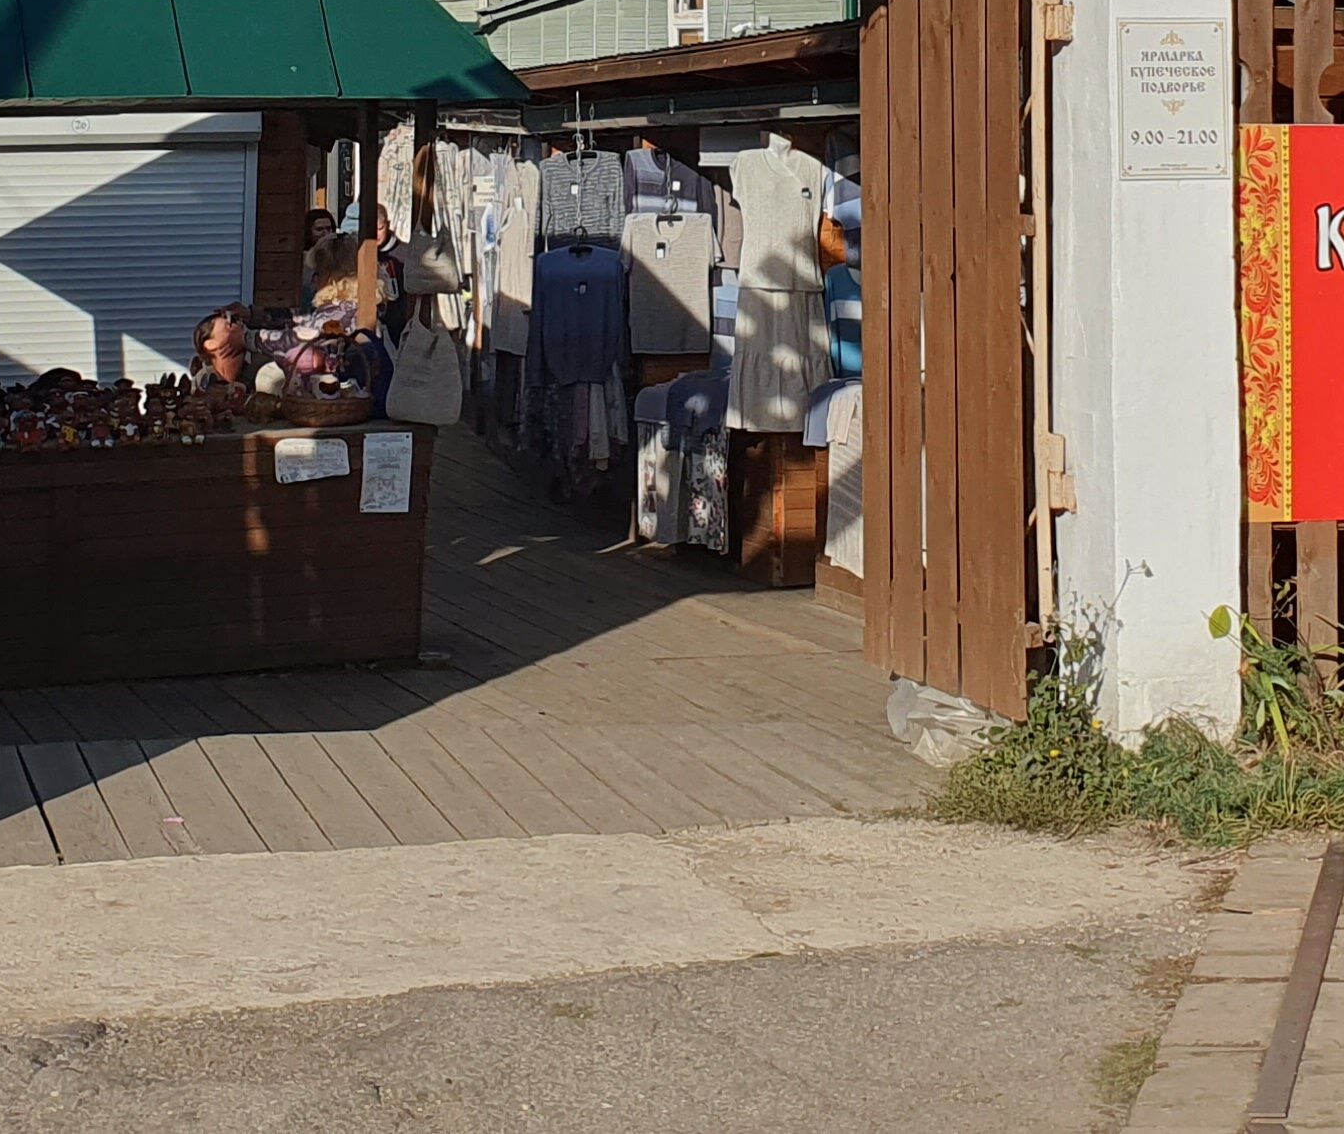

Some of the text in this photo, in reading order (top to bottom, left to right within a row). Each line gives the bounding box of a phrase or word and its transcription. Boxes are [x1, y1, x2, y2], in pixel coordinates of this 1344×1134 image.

[1141, 50, 1204, 62] ЯРМАРКА
[1130, 65, 1216, 80] КУПЕЧЕСКОЕ
[1141, 81, 1207, 94] ПОДВОРЬЕ
